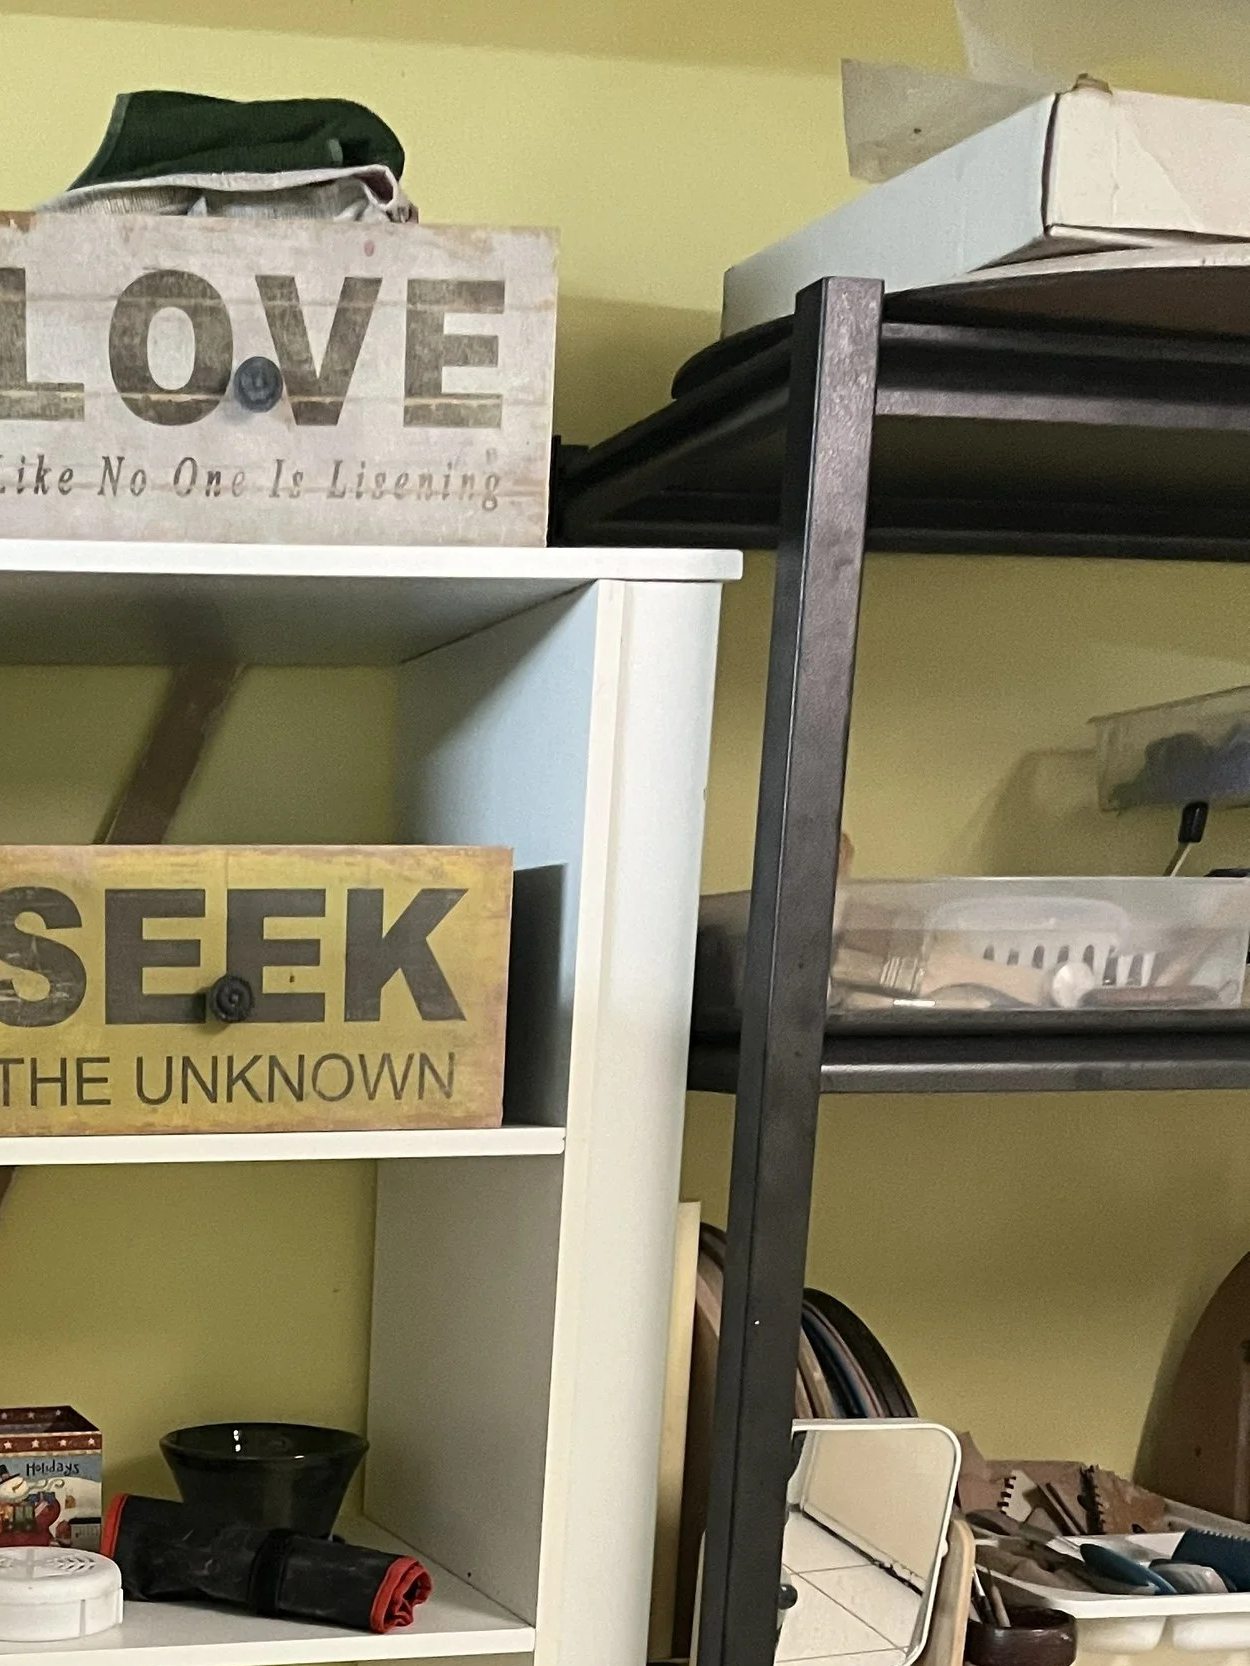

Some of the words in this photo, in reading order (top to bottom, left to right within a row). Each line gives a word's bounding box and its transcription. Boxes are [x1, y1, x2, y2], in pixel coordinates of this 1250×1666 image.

[97, 455, 148, 499] No
[172, 455, 246, 500] One
[268, 458, 306, 499] Is
[134, 1051, 457, 1106] UNKNOWN
[25, 1458, 81, 1477] Holidays
